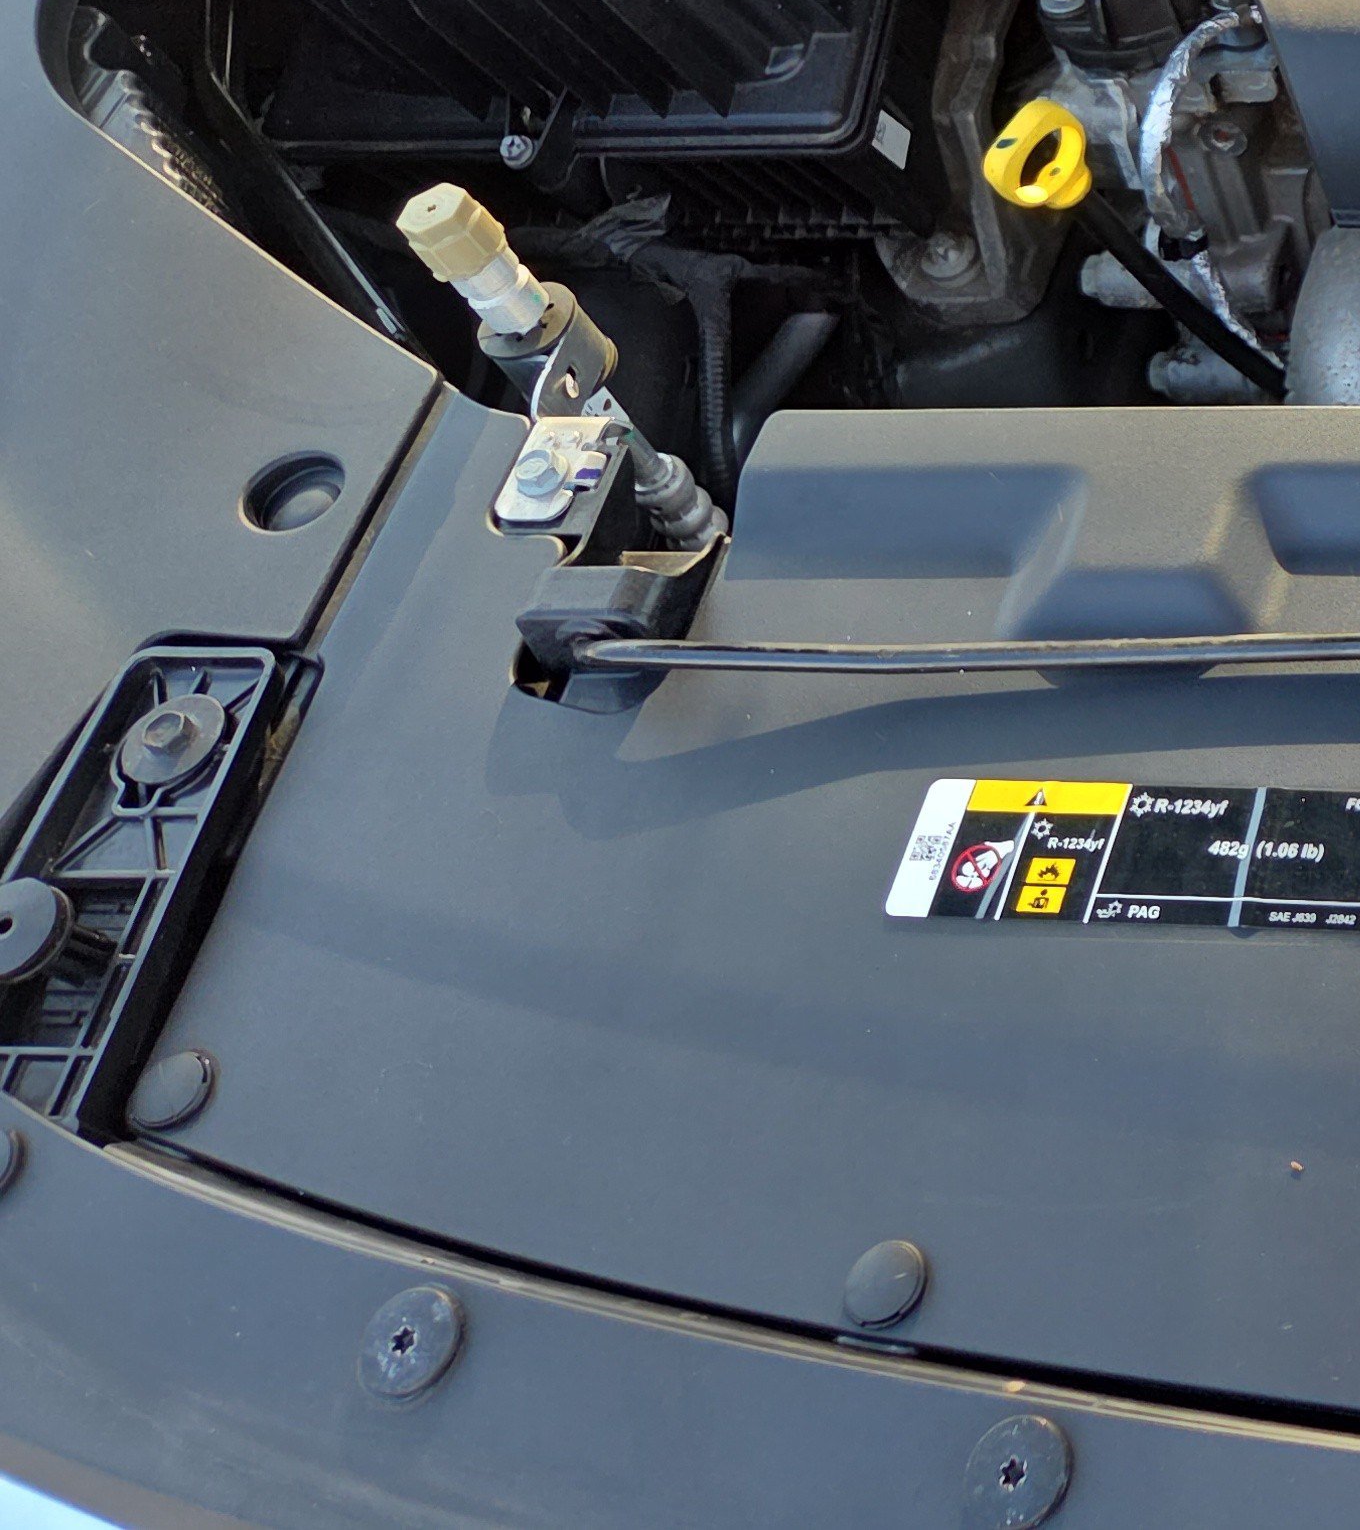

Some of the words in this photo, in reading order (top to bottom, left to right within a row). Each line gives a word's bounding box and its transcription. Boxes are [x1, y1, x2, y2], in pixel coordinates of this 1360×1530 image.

[1154, 798, 1230, 817] R-1234yf
[1208, 840, 1250, 860] 482g
[1255, 841, 1299, 860] (1.06
[1300, 843, 1325, 862] lb)
[1127, 904, 1161, 920] PAG
[1268, 911, 1291, 923] SAE
